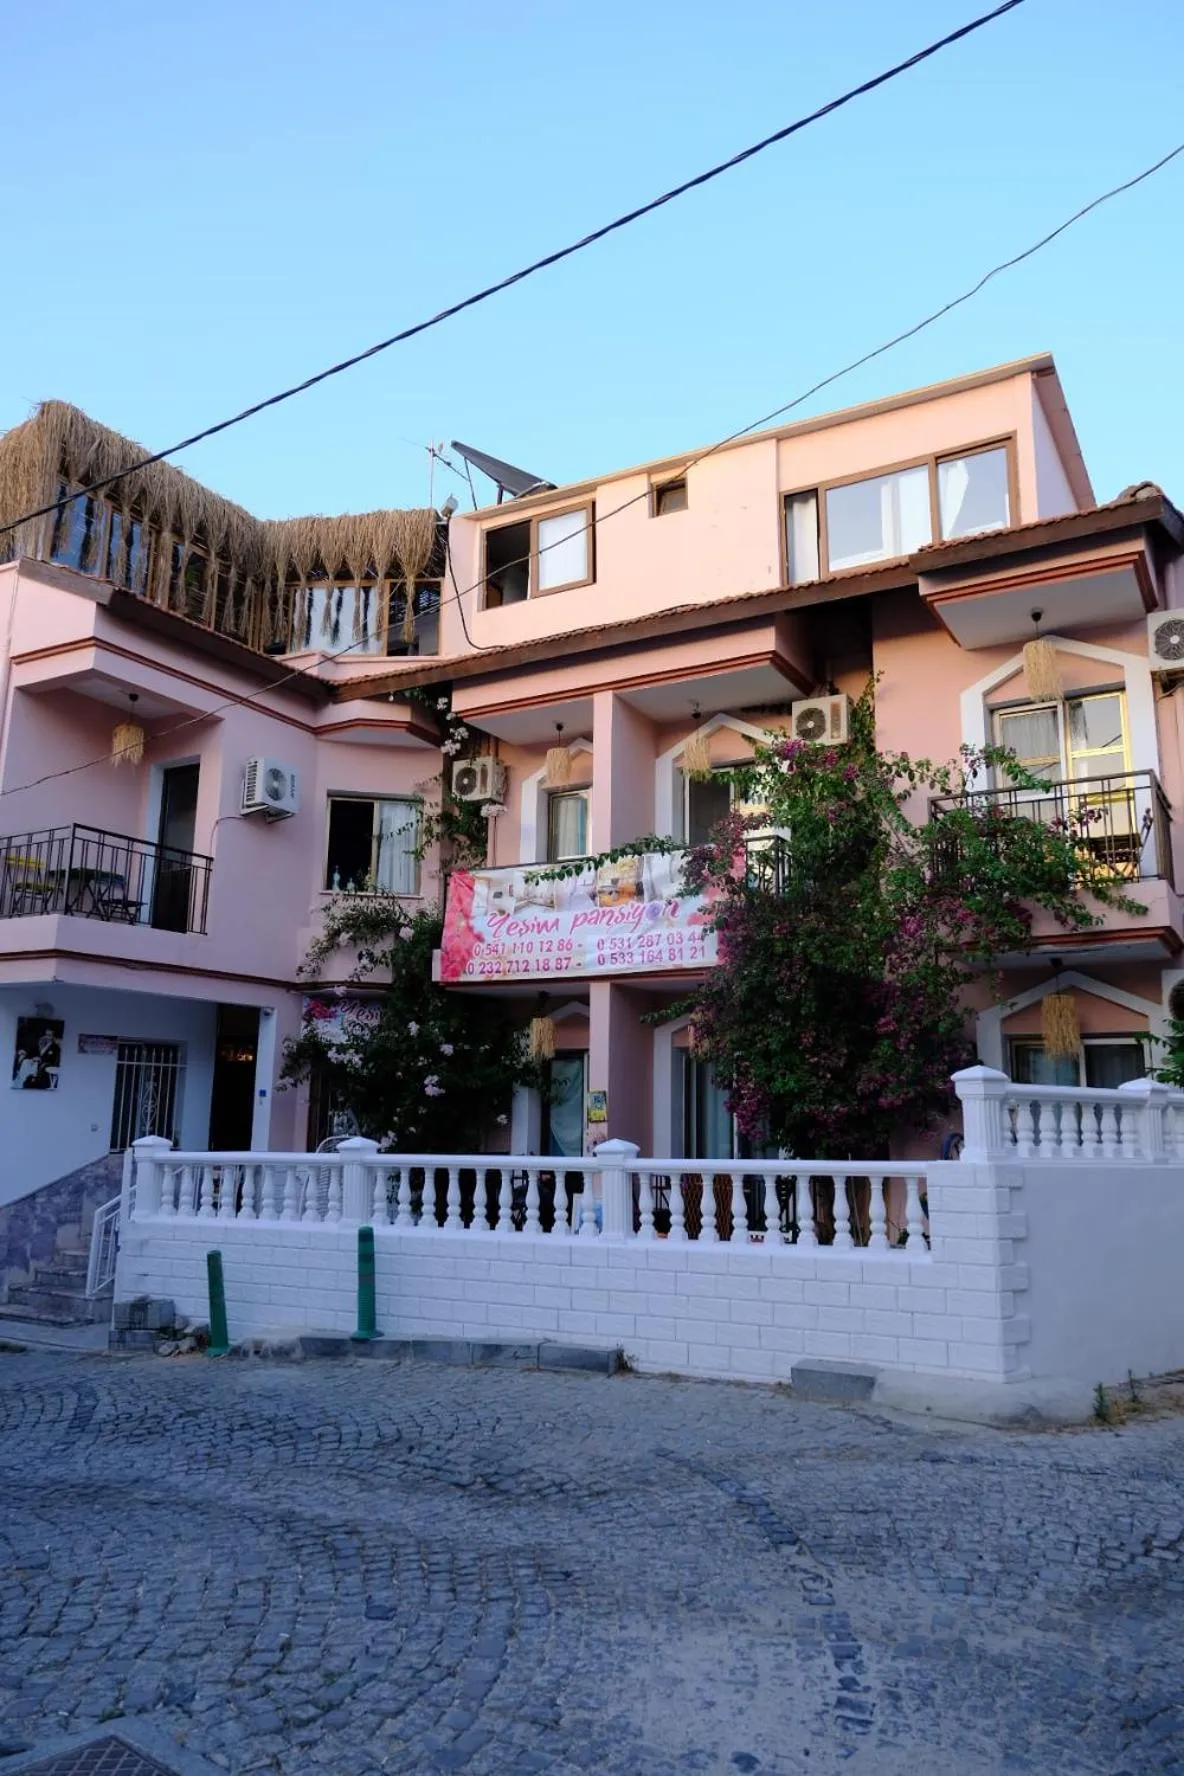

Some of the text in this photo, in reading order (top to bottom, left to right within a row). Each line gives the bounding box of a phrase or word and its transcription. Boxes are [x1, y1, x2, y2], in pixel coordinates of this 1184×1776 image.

[540, 940, 553, 953] 12
[597, 938, 605, 951] 0
[667, 932, 683, 946] 03
[467, 962, 475, 976] 0
[479, 961, 502, 975] 232
[507, 960, 530, 973] 712
[535, 958, 550, 972] 18
[555, 956, 572, 971] 87
[597, 953, 606, 966] 0
[610, 951, 634, 965] 533
[690, 945, 705, 959] 21
